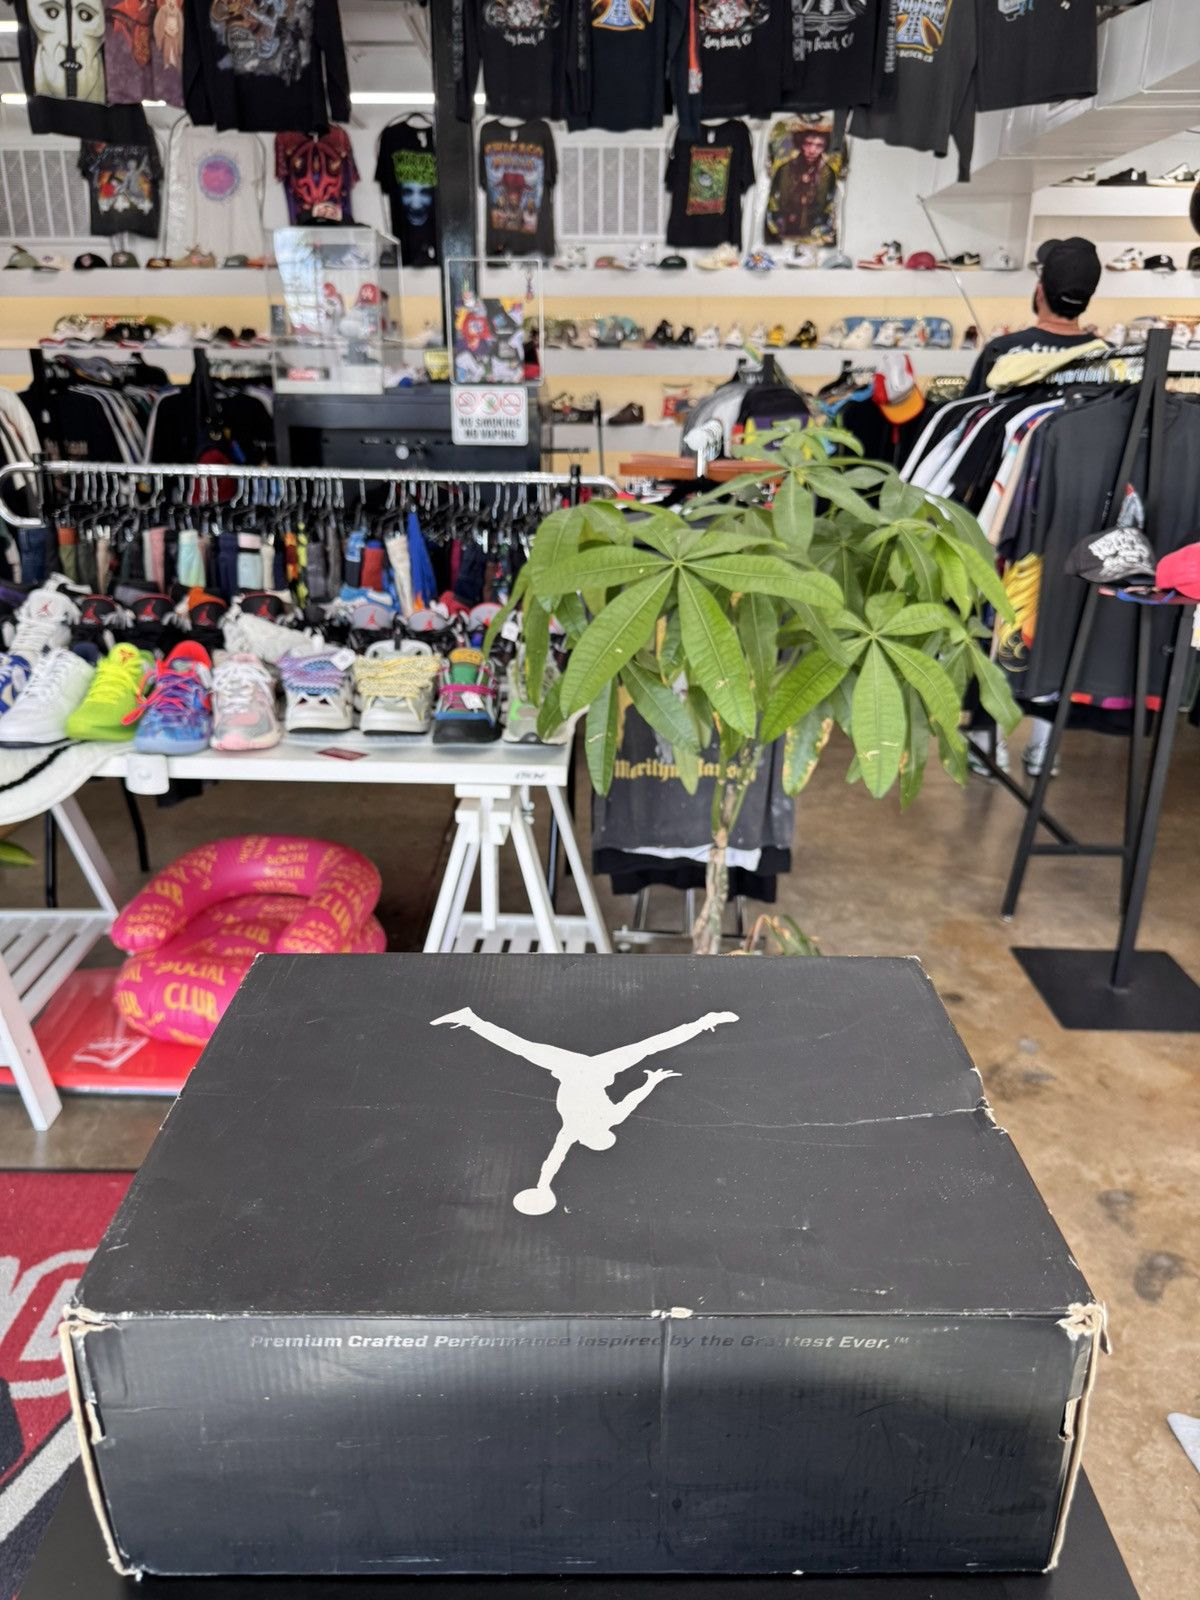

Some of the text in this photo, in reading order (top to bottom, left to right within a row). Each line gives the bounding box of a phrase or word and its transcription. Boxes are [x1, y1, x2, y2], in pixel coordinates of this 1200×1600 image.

[459, 417, 522, 429] NO SMOKING
[464, 429, 478, 440] NO
[163, 981, 219, 1023] CLUB
[250, 1334, 342, 1348] Premium
[348, 1334, 429, 1348] Crafted
[434, 1335, 571, 1348] Performance
[669, 1335, 696, 1349] by
[700, 1335, 734, 1347] the
